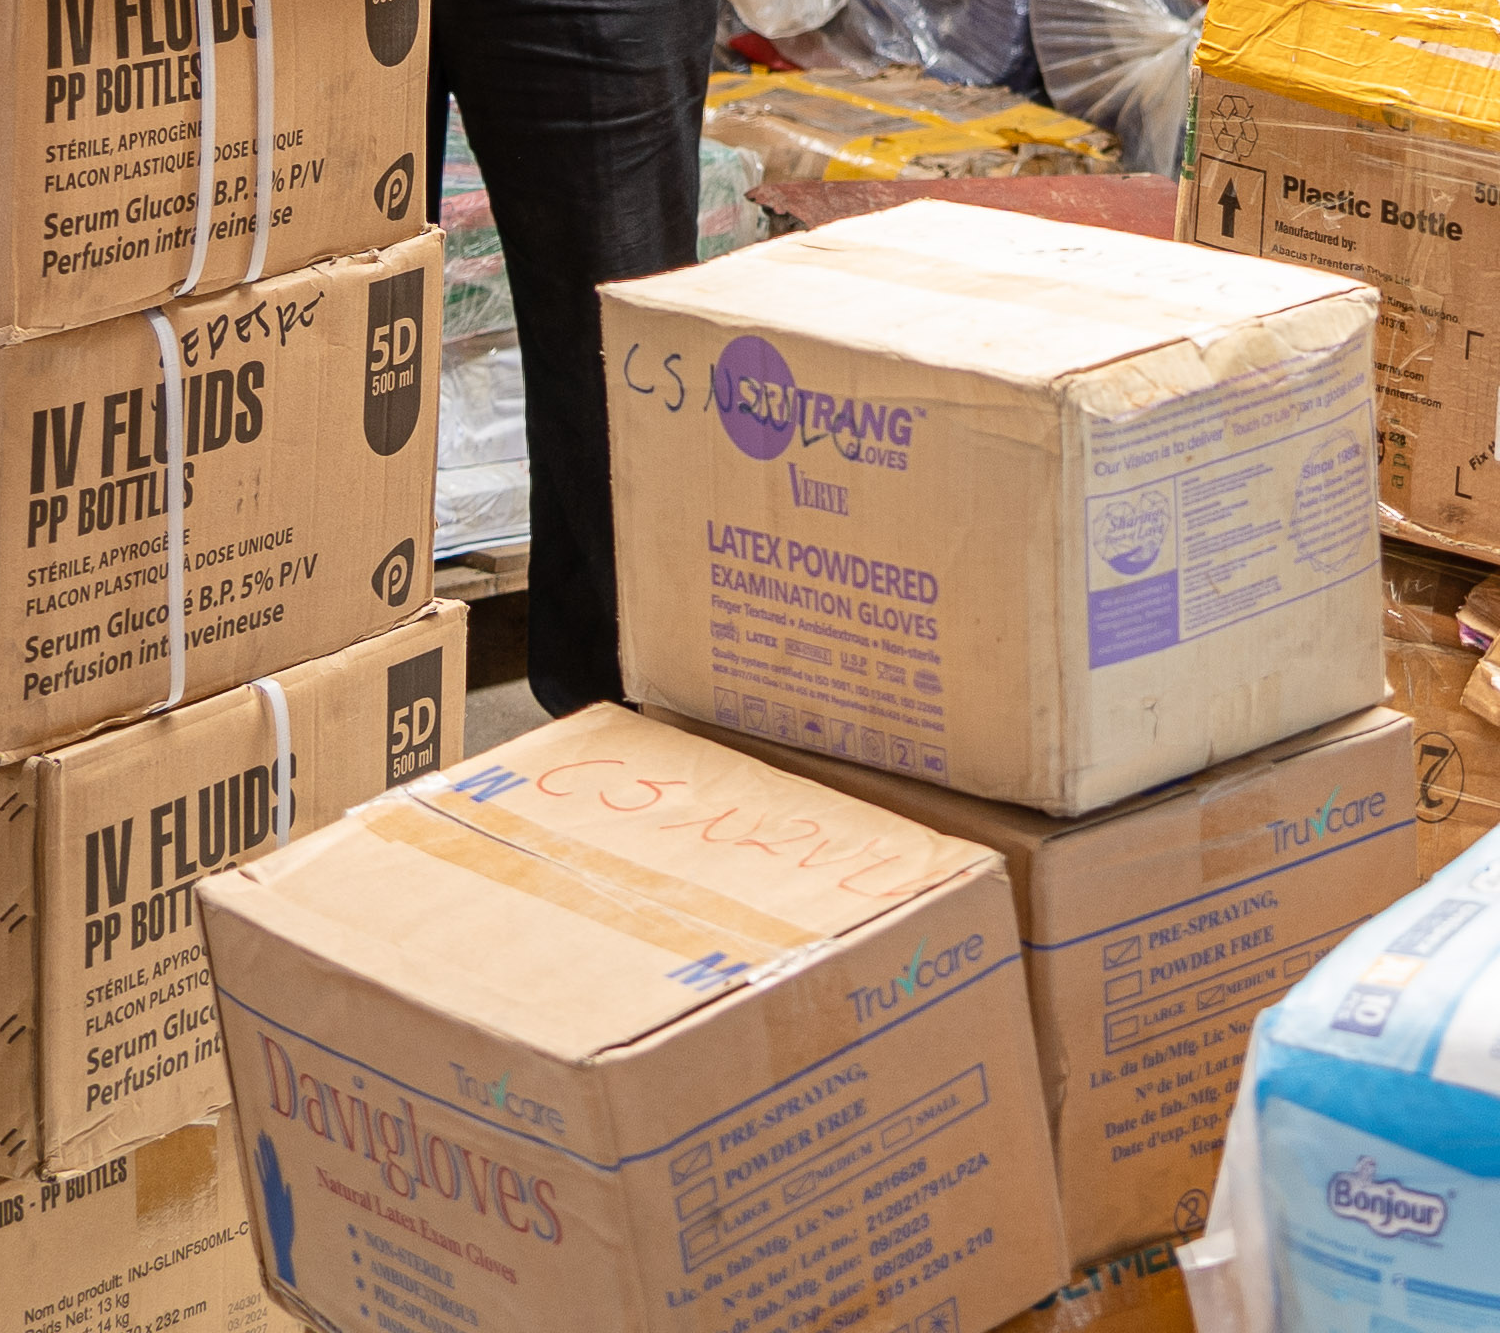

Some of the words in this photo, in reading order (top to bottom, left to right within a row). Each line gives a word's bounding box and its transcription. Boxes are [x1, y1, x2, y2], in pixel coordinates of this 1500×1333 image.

[1274, 220, 1339, 249] Manufactured
[1282, 175, 1372, 220] Plastic
[1380, 199, 1463, 242] Bottle
[1271, 244, 1308, 262] Abacus
[370, 316, 416, 373] 5D
[30, 401, 85, 495] IV
[102, 361, 265, 479] FLUIDS
[27, 494, 68, 548] PP
[707, 519, 782, 569] LATEX
[788, 540, 939, 606] POWDERED
[711, 563, 853, 620] EXAMINATION
[858, 601, 938, 641] GLOVES
[391, 697, 437, 755] 5D
[85, 817, 134, 918] IV
[150, 752, 297, 891] FLUIDS
[257, 1031, 563, 1246] Davigloves
[724, 1128, 814, 1190] POWDER
[816, 1098, 868, 1139] FREE
[316, 1165, 372, 1212] Natural
[376, 1195, 418, 1233] Latex
[465, 1242, 517, 1285] Gloves
[1333, 1176, 1444, 1233] Bonjour
